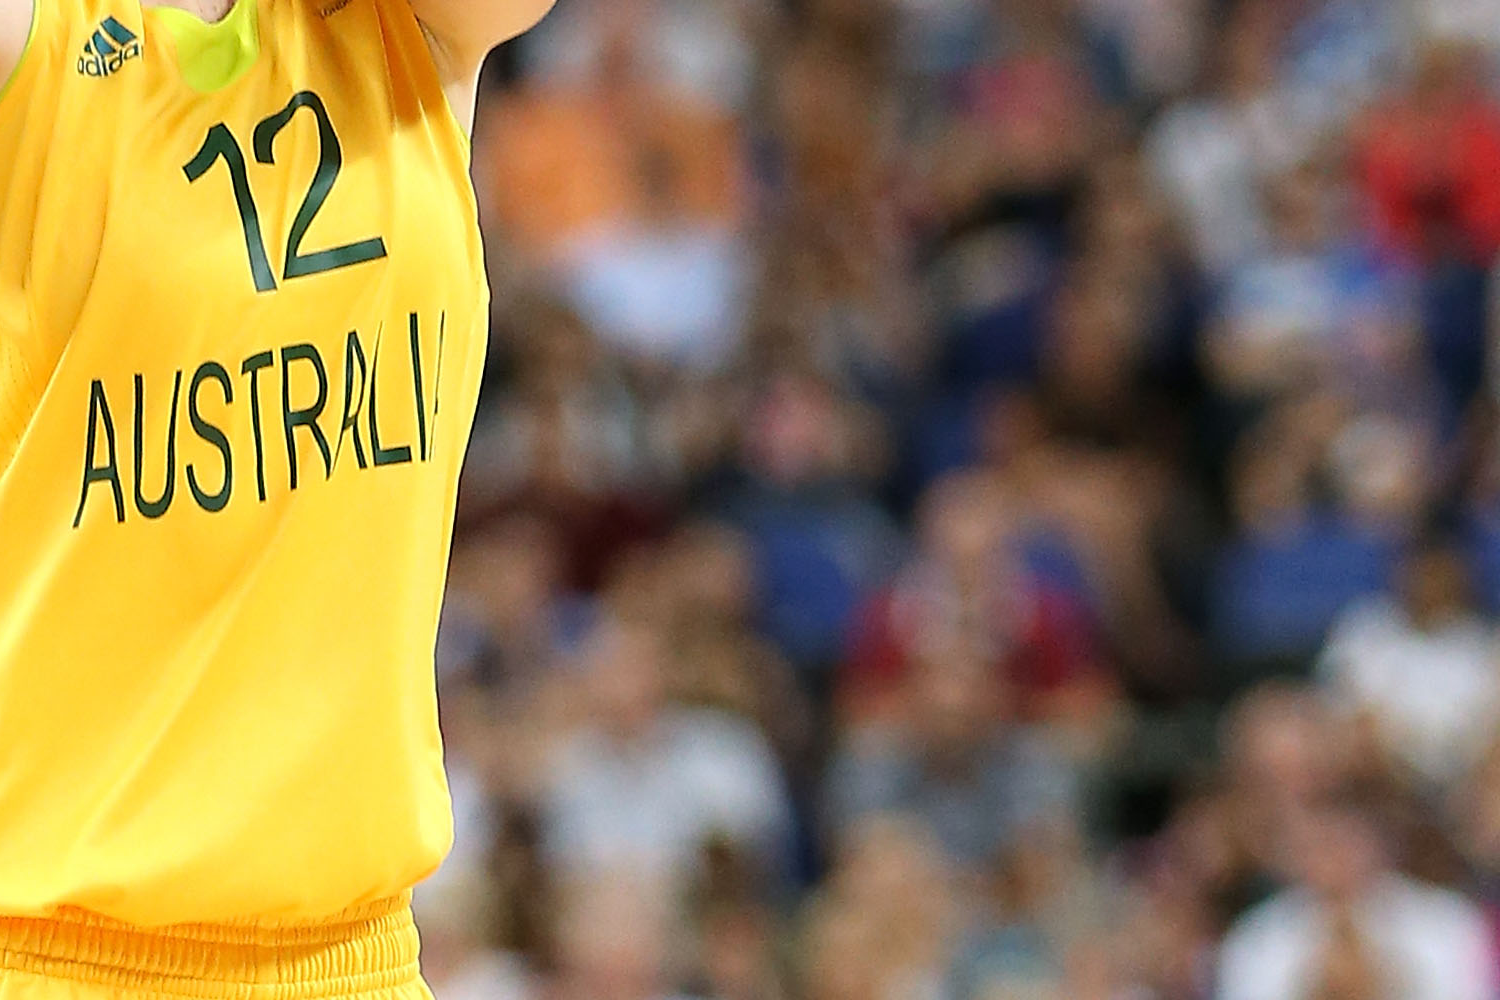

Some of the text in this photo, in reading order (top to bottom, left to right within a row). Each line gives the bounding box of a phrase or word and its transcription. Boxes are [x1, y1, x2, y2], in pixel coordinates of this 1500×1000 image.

[77, 42, 144, 77] adida
[182, 90, 387, 292] 12
[73, 310, 444, 528] AUSTRALI
